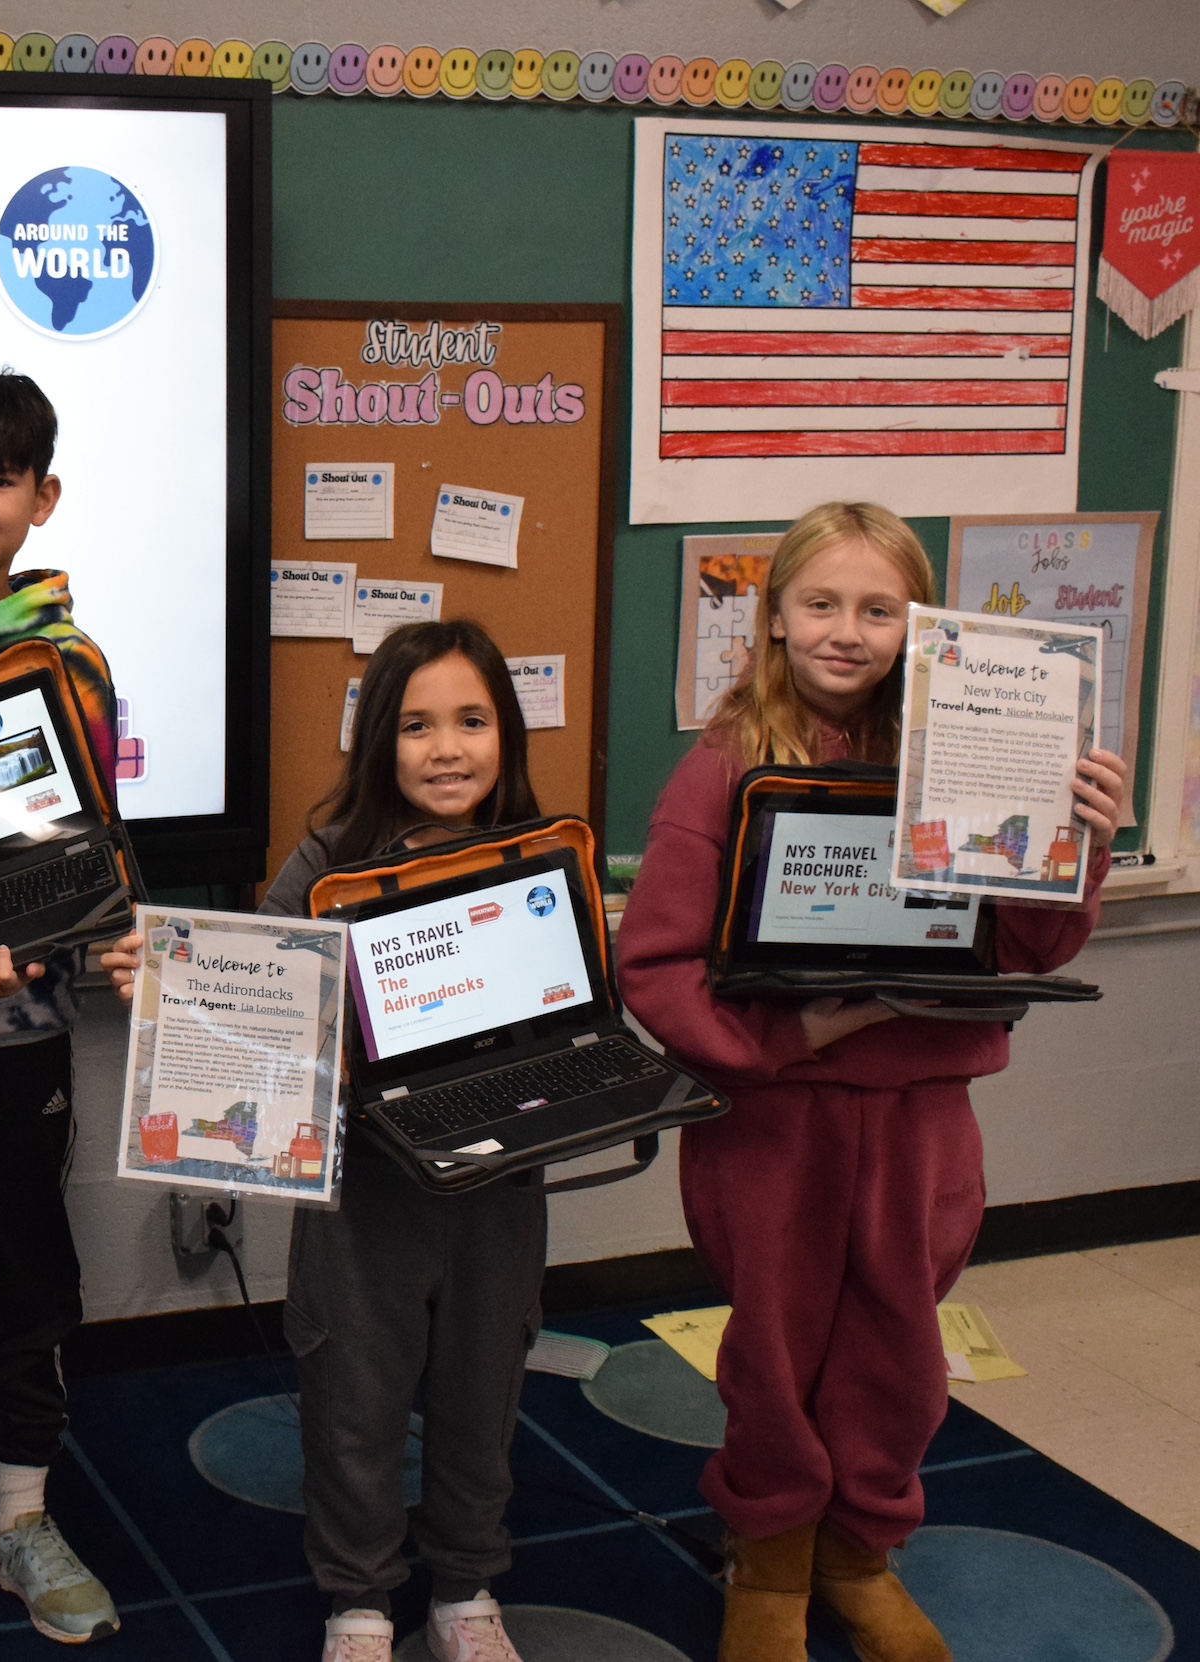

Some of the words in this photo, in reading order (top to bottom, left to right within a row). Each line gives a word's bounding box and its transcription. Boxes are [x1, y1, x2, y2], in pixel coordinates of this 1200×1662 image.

[1119, 194, 1186, 233] you're
[13, 223, 89, 241] AROUND
[96, 224, 129, 241] THE
[1127, 214, 1194, 247] magic
[12, 247, 130, 279] WORLD
[362, 320, 501, 368] Student
[282, 368, 585, 425] Shout-Outs
[322, 473, 349, 483] Shout
[351, 473, 367, 483] Out
[453, 496, 478, 509] Shout
[481, 501, 496, 512] Out
[1018, 532, 1091, 550] CLASS
[1031, 547, 1070, 573] Jobs
[282, 571, 310, 581] Shout
[312, 571, 328, 582] Out
[371, 589, 398, 600] Shout
[400, 590, 416, 601] Out
[981, 582, 1030, 615] Job
[1055, 583, 1125, 611] Student
[964, 657, 1026, 679] Welcome
[1030, 665, 1050, 681] to
[963, 684, 991, 698] New
[993, 686, 1021, 701] York
[1023, 690, 1047, 707] City
[930, 698, 964, 711] Travel
[966, 702, 1002, 716] Agent:
[1005, 707, 1034, 718] Nicole
[785, 844, 816, 859] NYS
[823, 845, 877, 861] TRAVEL
[782, 862, 868, 878] BROCHURE:
[780, 880, 816, 895] New
[824, 881, 860, 896] York
[530, 898, 552, 910] WORLD
[370, 936, 401, 957] NYS
[406, 920, 463, 946] TRAVEL
[196, 953, 261, 975] Welcome
[266, 961, 288, 978] to
[374, 941, 460, 975] BROCHURE:
[186, 978, 210, 992] The
[212, 982, 293, 1001] Adirondacks
[377, 977, 408, 994] The
[161, 993, 197, 1006] Travel
[198, 998, 236, 1011] Agent:
[384, 977, 484, 1014] Adirondacks
[239, 1002, 255, 1013] Lia
[254, 1004, 304, 1018] Lombelino
[473, 1036, 496, 1050] acer
